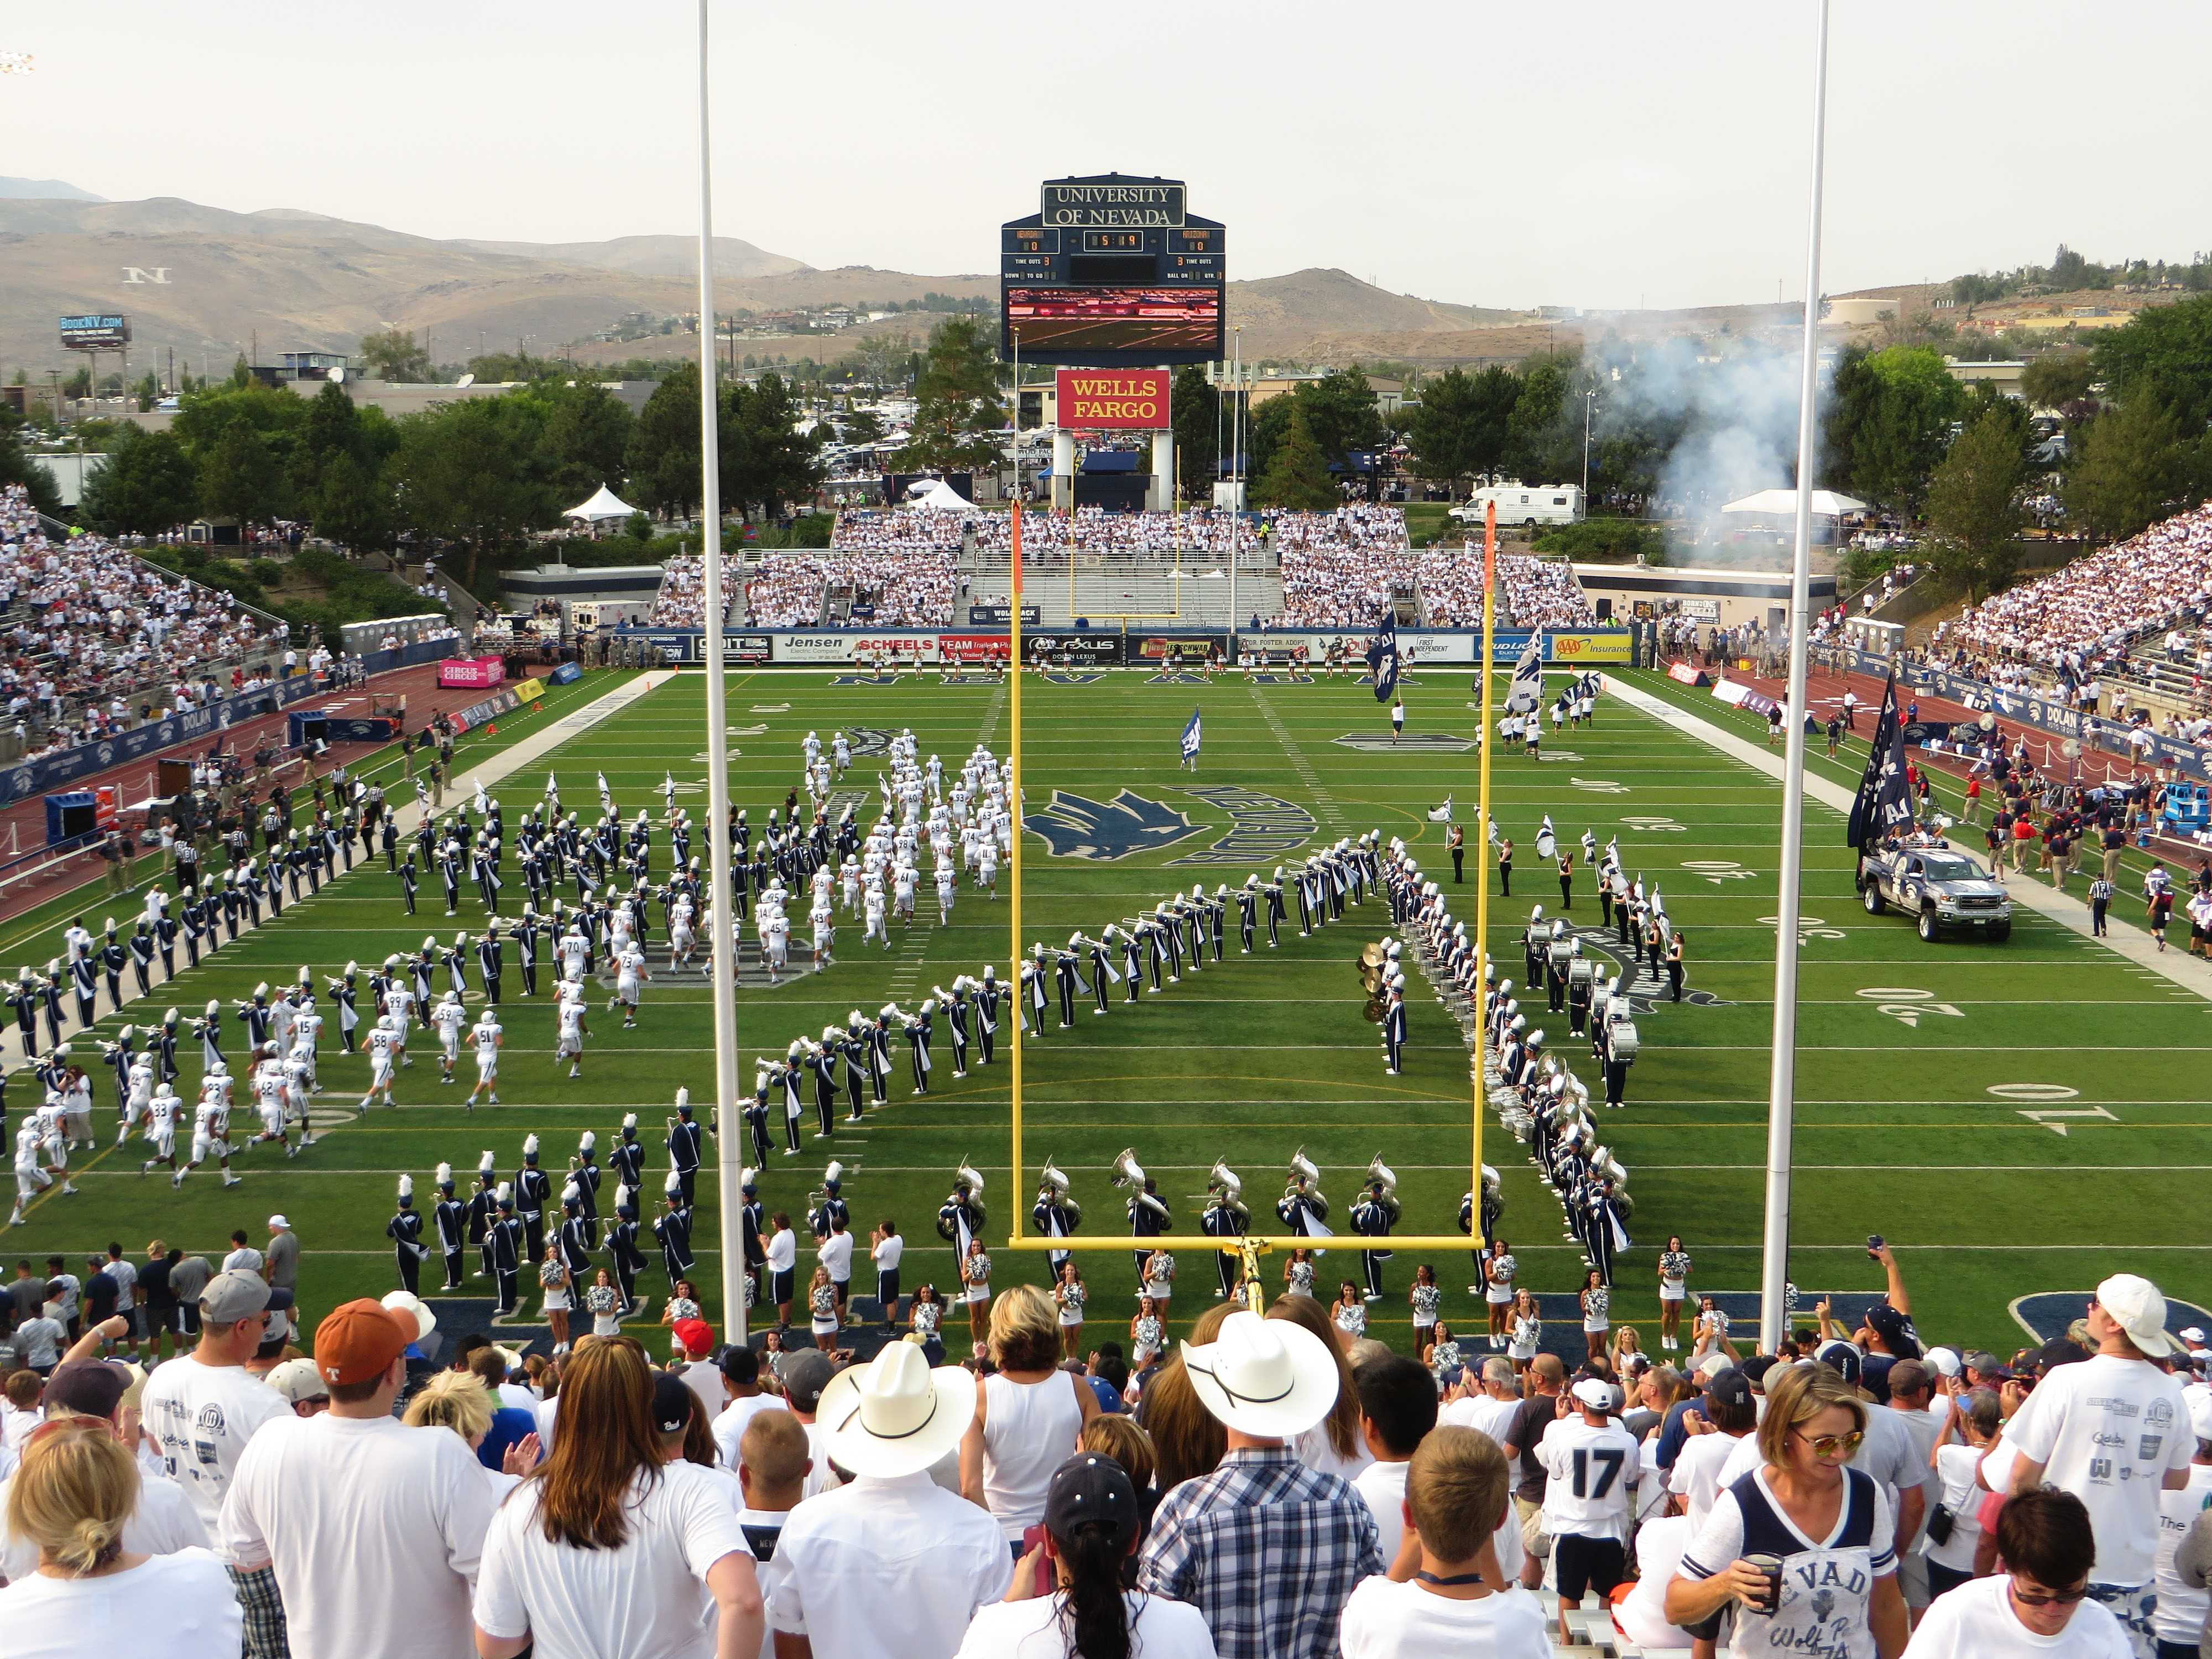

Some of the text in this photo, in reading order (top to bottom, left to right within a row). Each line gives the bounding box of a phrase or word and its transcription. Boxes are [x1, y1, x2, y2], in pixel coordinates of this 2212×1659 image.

[1056, 188, 1170, 202] UNIVERSITY
[1056, 210, 1172, 225] OF NEVADA
[1102, 235, 1136, 246] 5:19
[1031, 242, 1037, 251] 0
[1197, 242, 1203, 251] 0
[1044, 257, 1050, 266] 3
[1177, 257, 1183, 266] 3
[122, 267, 173, 284] N
[1072, 380, 1157, 397] WELLS
[1073, 402, 1157, 418] FARGO
[1637, 605, 1651, 616] 25
[785, 637, 843, 647] Jensen
[860, 640, 933, 650] SCHEELS
[940, 641, 972, 649] TEAM
[1557, 640, 1580, 653] AAA
[182, 709, 213, 731] DOLAN
[2047, 706, 2077, 728] DOLAN
[2047, 721, 2077, 734] AUTO GROUP
[909, 794, 917, 802] 60
[983, 811, 991, 820] 63
[931, 823, 940, 832] 68
[997, 818, 1005, 827] 97
[1158, 785, 1319, 866] NEVADA
[1619, 816, 1688, 832] 50
[966, 832, 975, 841] 74
[899, 839, 908, 848] 98
[938, 845, 945, 854] 91
[983, 849, 988, 858] 11
[844, 869, 853, 878] 82
[1679, 861, 1757, 880] 40
[815, 877, 825, 886] 56
[901, 873, 909, 882] 61
[940, 874, 949, 883] 30
[868, 897, 875, 906] 16
[675, 909, 682, 919] 19
[760, 907, 768, 917] 14
[815, 913, 823, 923] 43
[770, 924, 780, 933] 45
[567, 941, 579, 952] 70
[621, 956, 632, 968] 73
[390, 996, 402, 1008] 99
[1855, 987, 1965, 1018] 20
[440, 1008, 452, 1020] 59
[565, 1010, 571, 1021] 4
[300, 1021, 310, 1033] 15
[374, 1035, 388, 1047] 58
[479, 1029, 491, 1042] 51
[262, 1081, 273, 1095] 62
[1986, 1083, 2121, 1121] 10
[155, 1103, 166, 1117] 33
[326, 1366, 340, 1381] T
[1735, 1391, 1745, 1405] N
[664, 1419, 680, 1431] Pack
[1572, 1448, 1625, 1500] 17
[2159, 1515, 2186, 1531] The
[1770, 1625, 1823, 1656] Wolf
